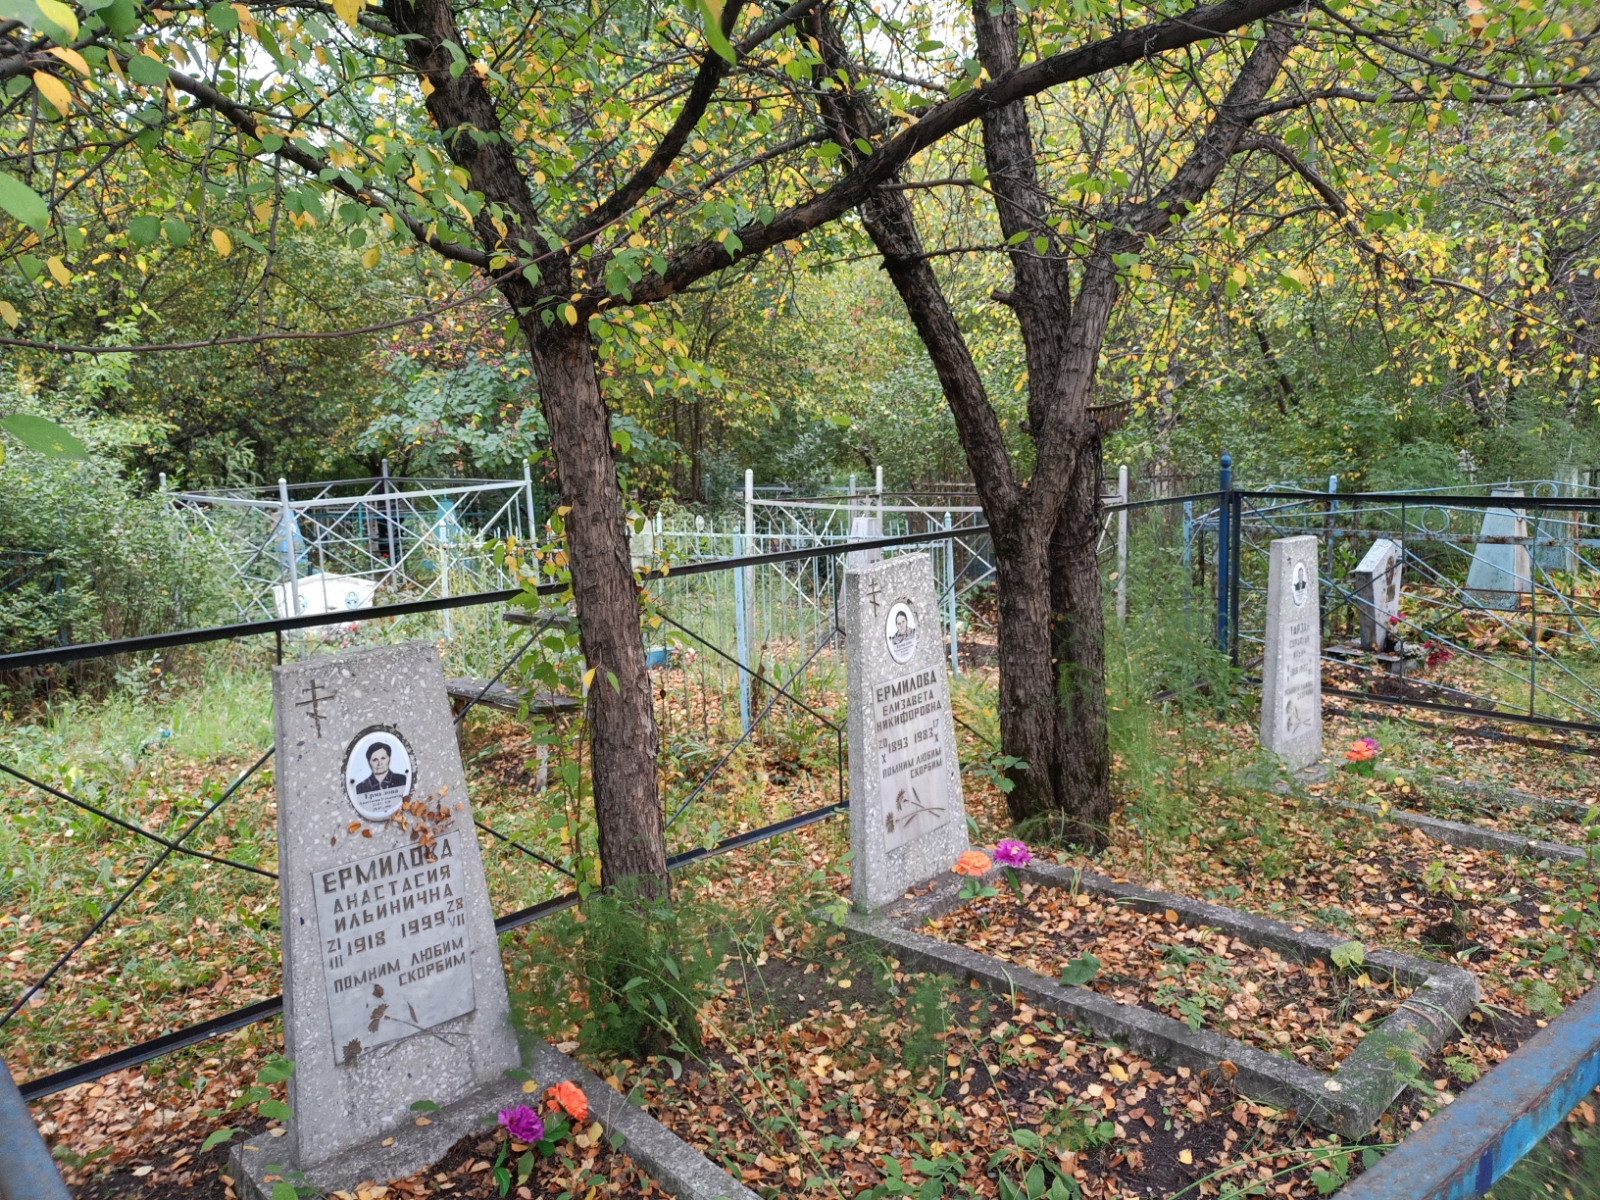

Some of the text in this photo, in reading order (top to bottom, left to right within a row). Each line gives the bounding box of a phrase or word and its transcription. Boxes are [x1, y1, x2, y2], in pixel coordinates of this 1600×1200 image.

[876, 670, 937, 703] ЕРМИЛОВА
[876, 700, 942, 732] НИКИФОРОВНА
[882, 689, 934, 717] ЕЛИЗАВЕТА
[888, 727, 933, 754] 1893 1983
[882, 747, 942, 779] ПОМНИМ ЛЮБИМ
[910, 758, 942, 779] СКОРБИМ
[333, 864, 451, 915] АНАСТАСИЯ
[446, 897, 464, 913] 28
[334, 883, 454, 933] ИЛЬИНИЧНА
[327, 937, 342, 953] 21
[347, 910, 445, 956] 1918 1999
[333, 936, 464, 993] ПОМНИМ ЛЮБИМ
[398, 952, 466, 987] СКОРБИМ
